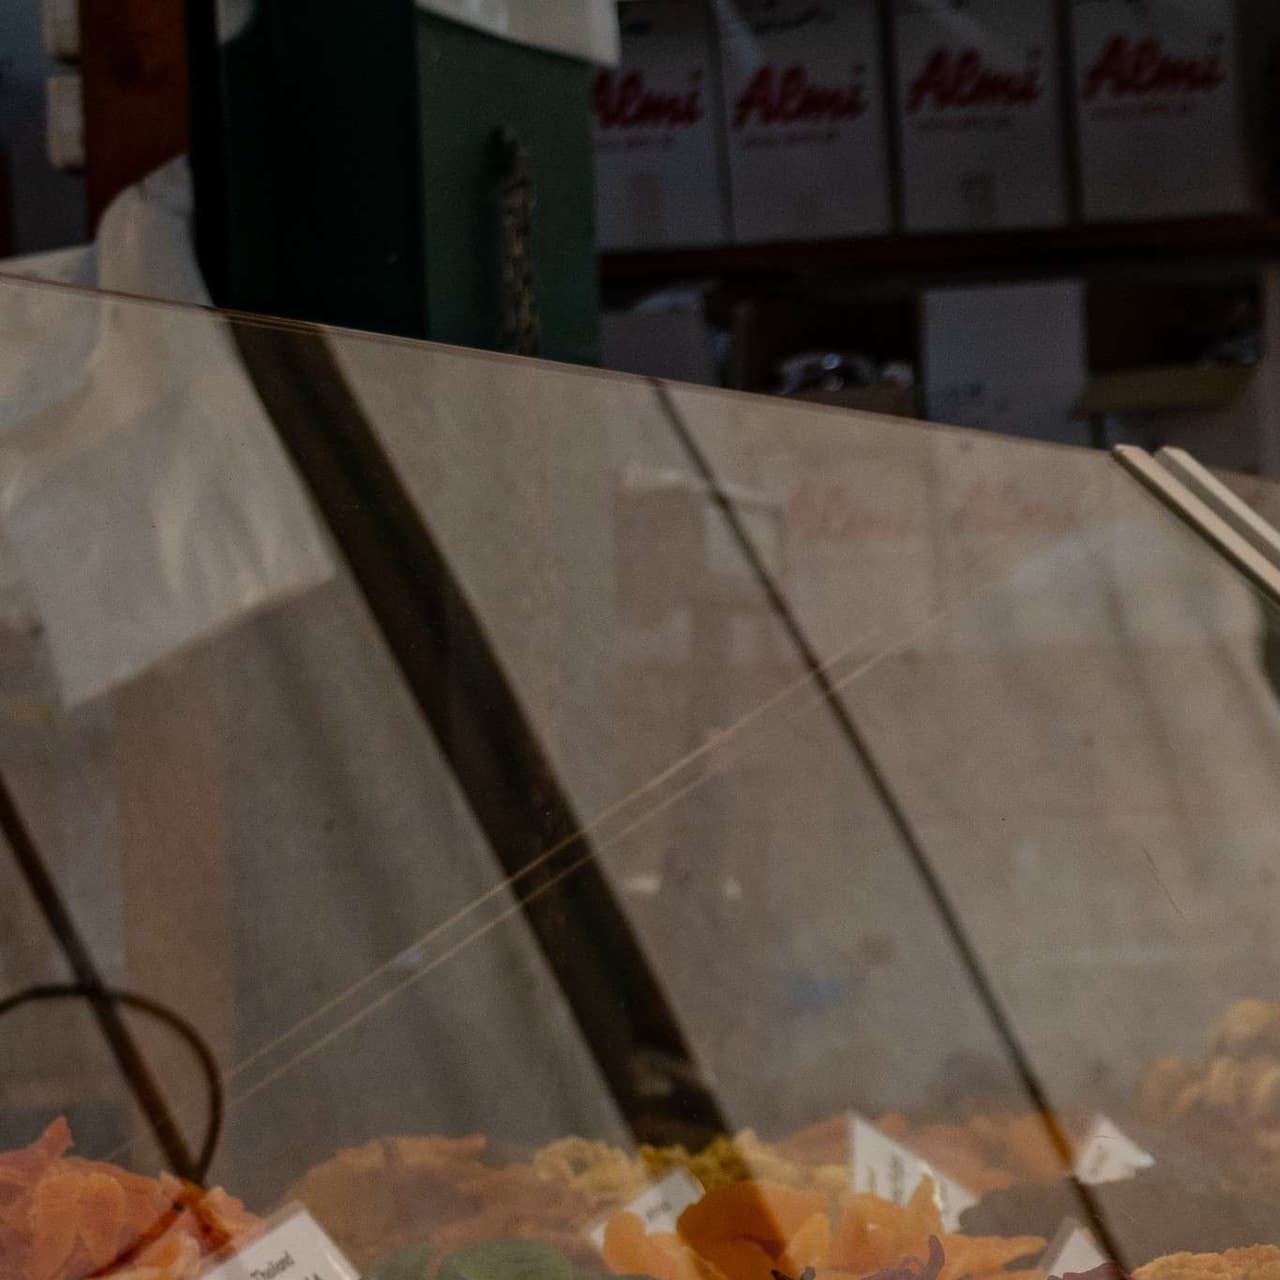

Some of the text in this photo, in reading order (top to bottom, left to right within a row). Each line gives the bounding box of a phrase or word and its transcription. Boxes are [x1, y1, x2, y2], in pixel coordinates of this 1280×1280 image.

[734, 62, 869, 131] Almi
[907, 46, 1042, 114] Almi
[1082, 33, 1225, 99] Almi
